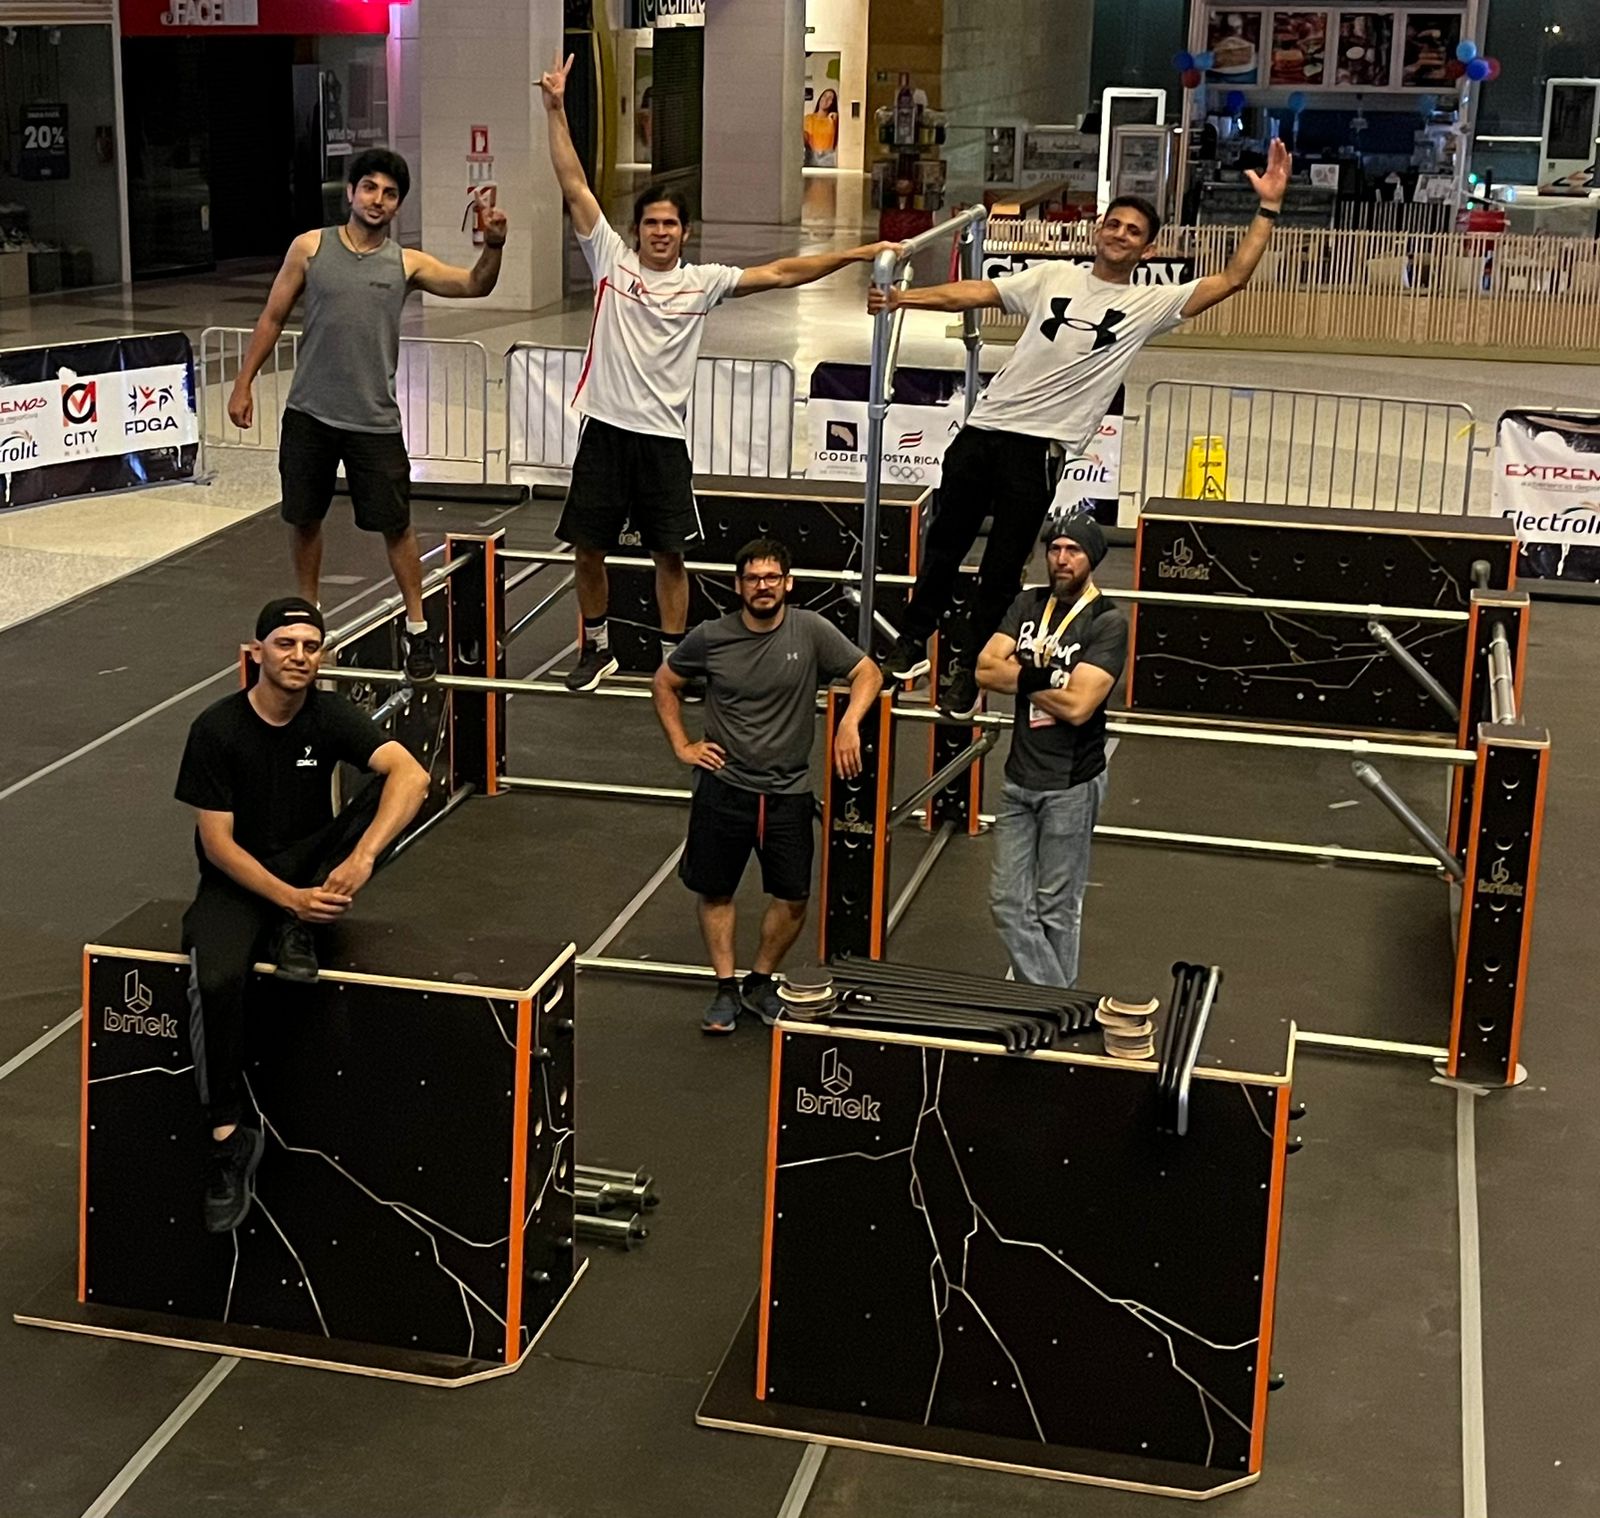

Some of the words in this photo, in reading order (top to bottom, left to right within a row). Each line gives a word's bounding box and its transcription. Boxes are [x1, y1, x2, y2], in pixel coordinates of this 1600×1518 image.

[24, 125, 65, 149] 20%
[124, 416, 178, 436] FDGA
[63, 429, 98, 447] CITY
[881, 454, 911, 464] OSTA
[914, 455, 939, 465] RICA
[1158, 561, 1210, 580] brick
[104, 1006, 178, 1038] brick
[797, 1086, 880, 1122] brick
